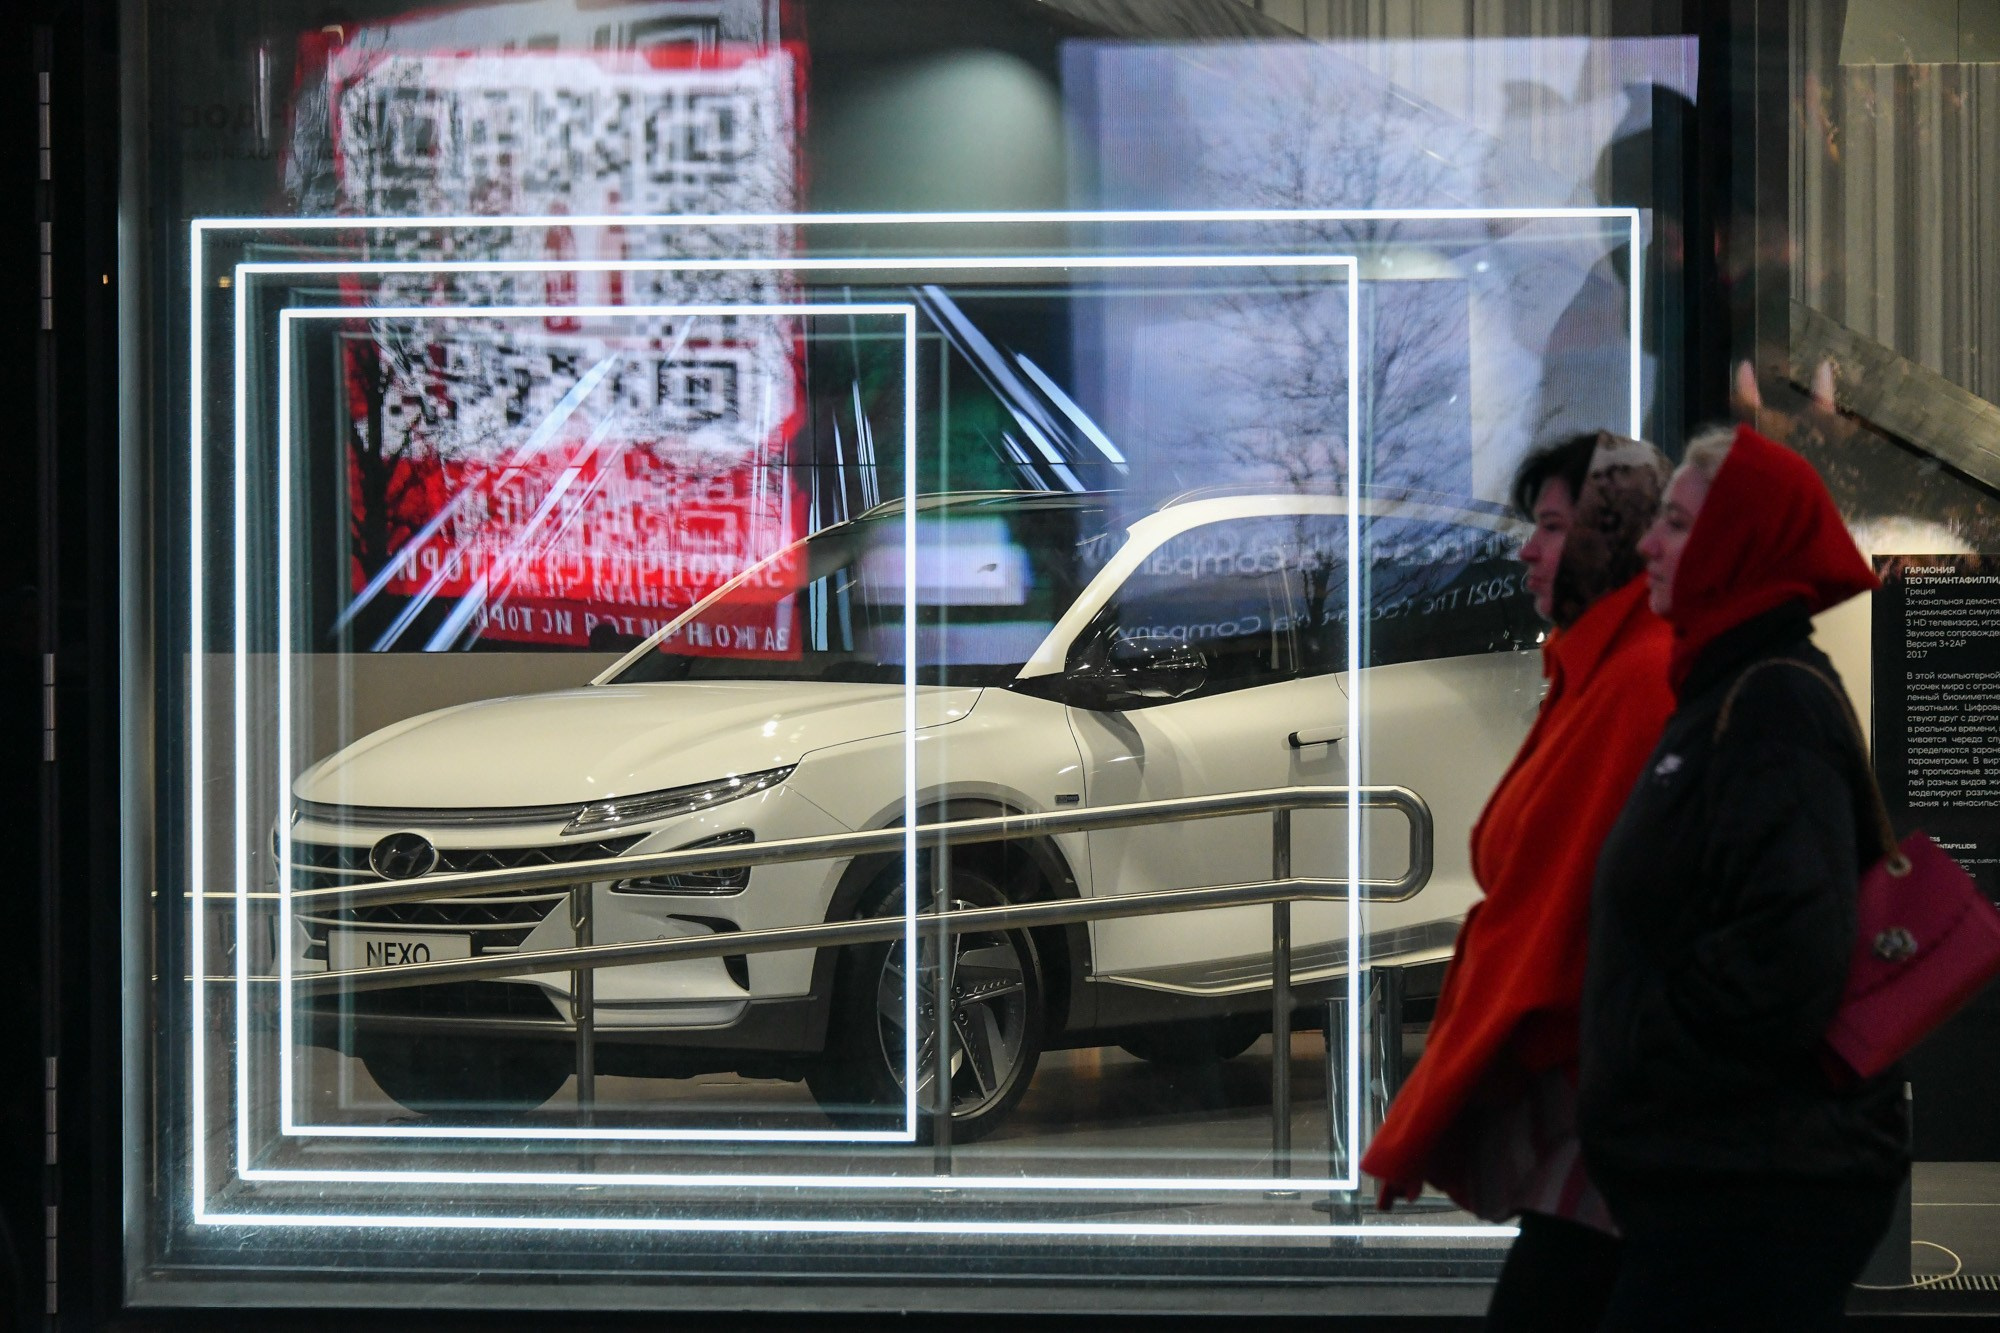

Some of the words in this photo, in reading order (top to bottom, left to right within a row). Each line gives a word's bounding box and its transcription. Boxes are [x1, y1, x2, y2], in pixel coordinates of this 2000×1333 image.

[1904, 566, 1956, 574] ГАРМОНИЯ
[1904, 577, 1923, 585] ТЕО
[1925, 576, 2000, 585] ТРИАНТАФИЛЛИ
[1905, 587, 1936, 596] Греция
[1905, 609, 1967, 617] динамическая
[1913, 619, 1927, 627] HD
[1906, 629, 1945, 638] Звуковое
[1906, 640, 1937, 649] Версия
[1906, 650, 1928, 659] 2017
[1906, 671, 1913, 680] В
[1915, 671, 1935, 680] этой
[1906, 683, 1940, 691] кусочек
[1941, 683, 1964, 691] мира
[1907, 692, 1940, 701] ленный
[1907, 704, 1959, 712] животными.
[1907, 715, 1937, 723] ствуют
[1938, 715, 1959, 723] друг
[1967, 715, 1998, 723] другом
[1914, 726, 1957, 734] реальном
[1952, 736, 1983, 744] череда
[1907, 747, 1969, 755] определяются
[1907, 758, 1969, 766] параметрами.
[1972, 756, 1980, 764] В
[1908, 778, 1924, 786] лей
[1927, 779, 1959, 787] разных
[1908, 790, 1962, 798] моделируют
[366, 941, 431, 967] NEXO
